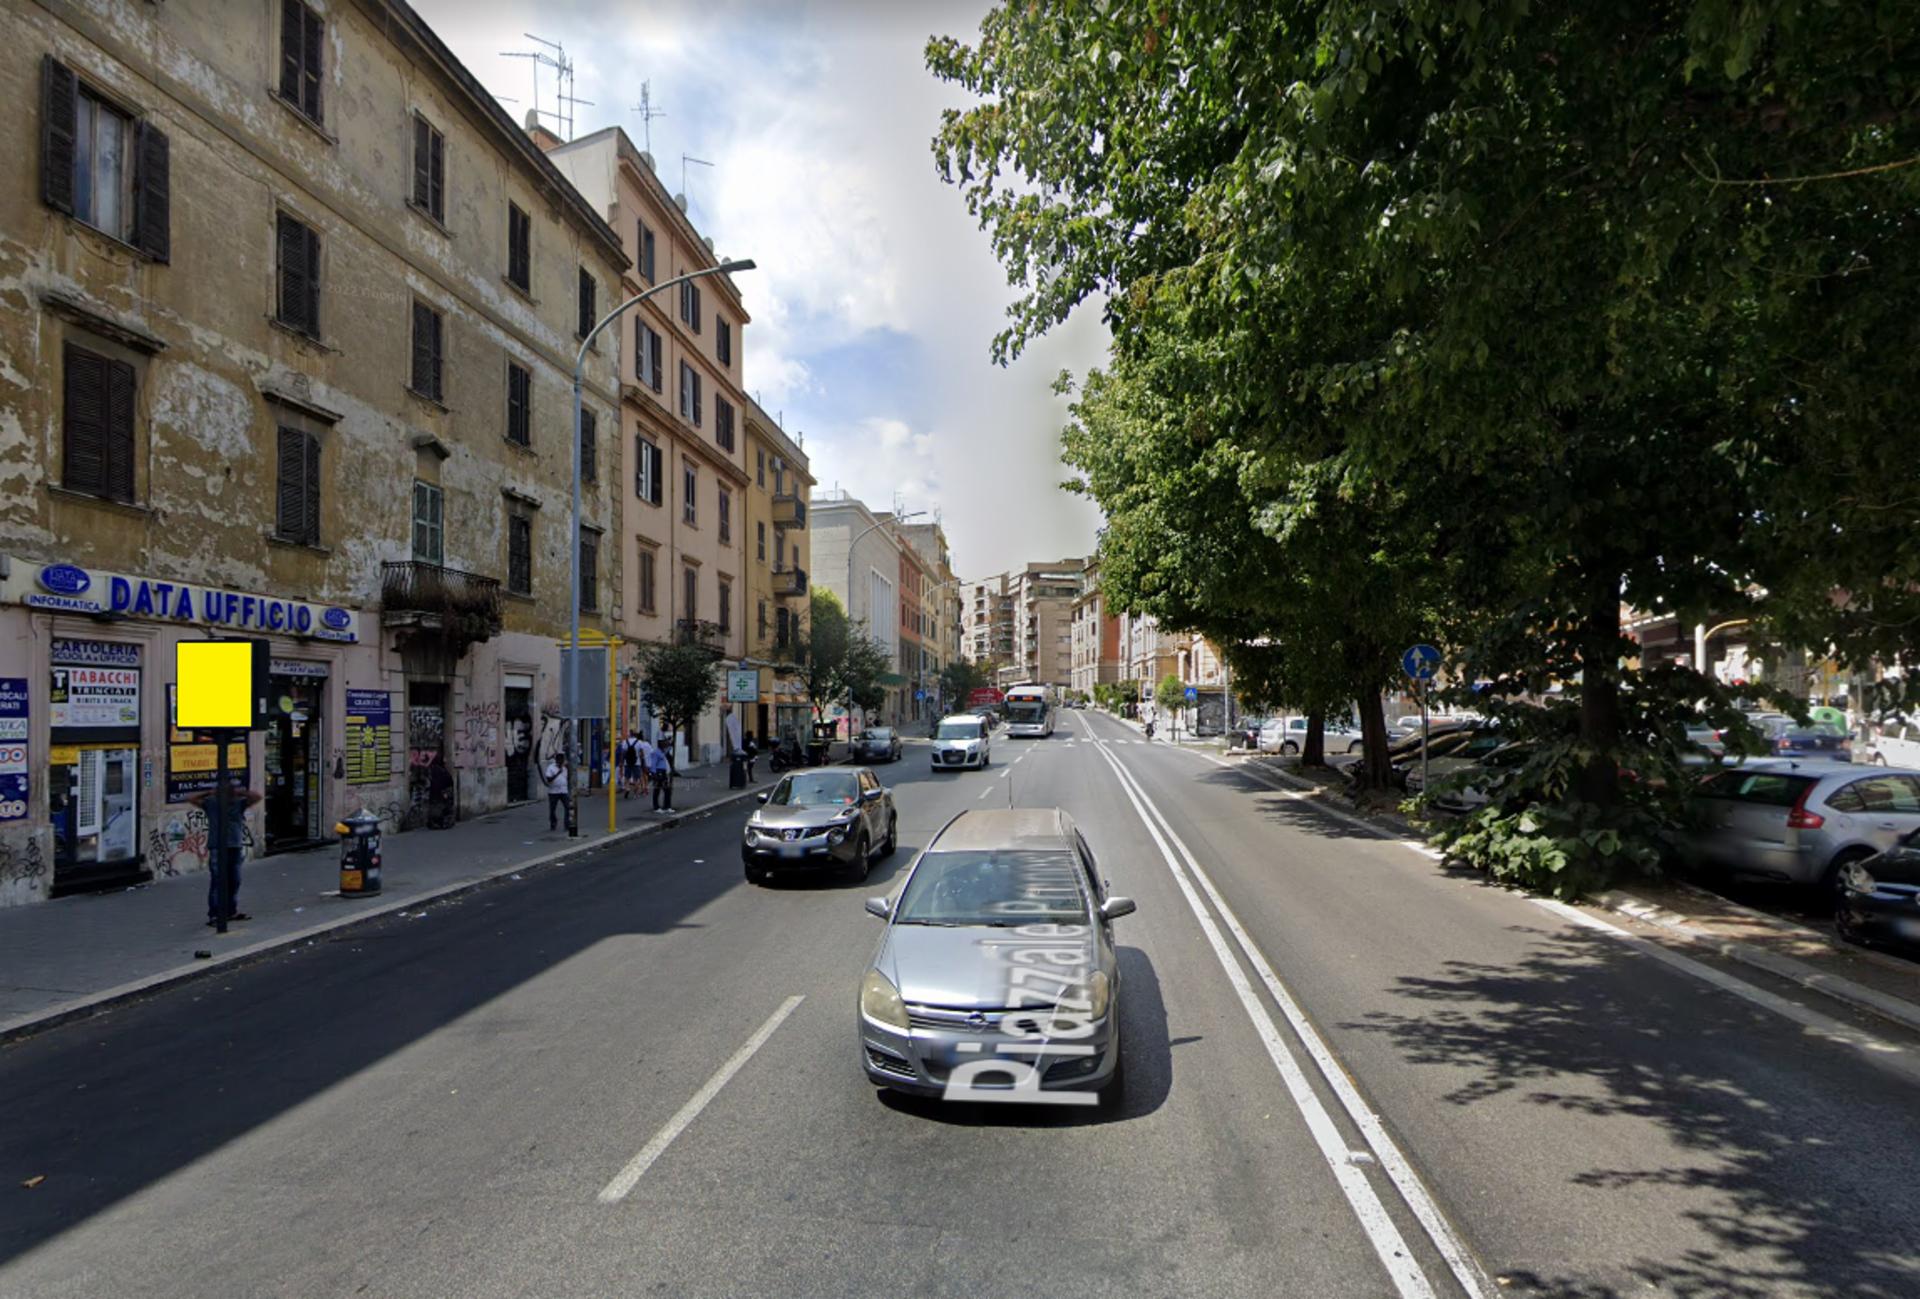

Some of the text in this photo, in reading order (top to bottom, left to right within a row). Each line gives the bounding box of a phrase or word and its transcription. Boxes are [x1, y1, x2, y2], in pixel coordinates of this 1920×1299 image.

[30, 595, 100, 612] INFORMATICA
[111, 576, 311, 632] DATA UFFICIO
[51, 641, 138, 656] CARTOLERIA
[52, 650, 92, 662] SCUOLA
[100, 655, 137, 664] UFFICIO
[72, 671, 137, 684] TABACCHI
